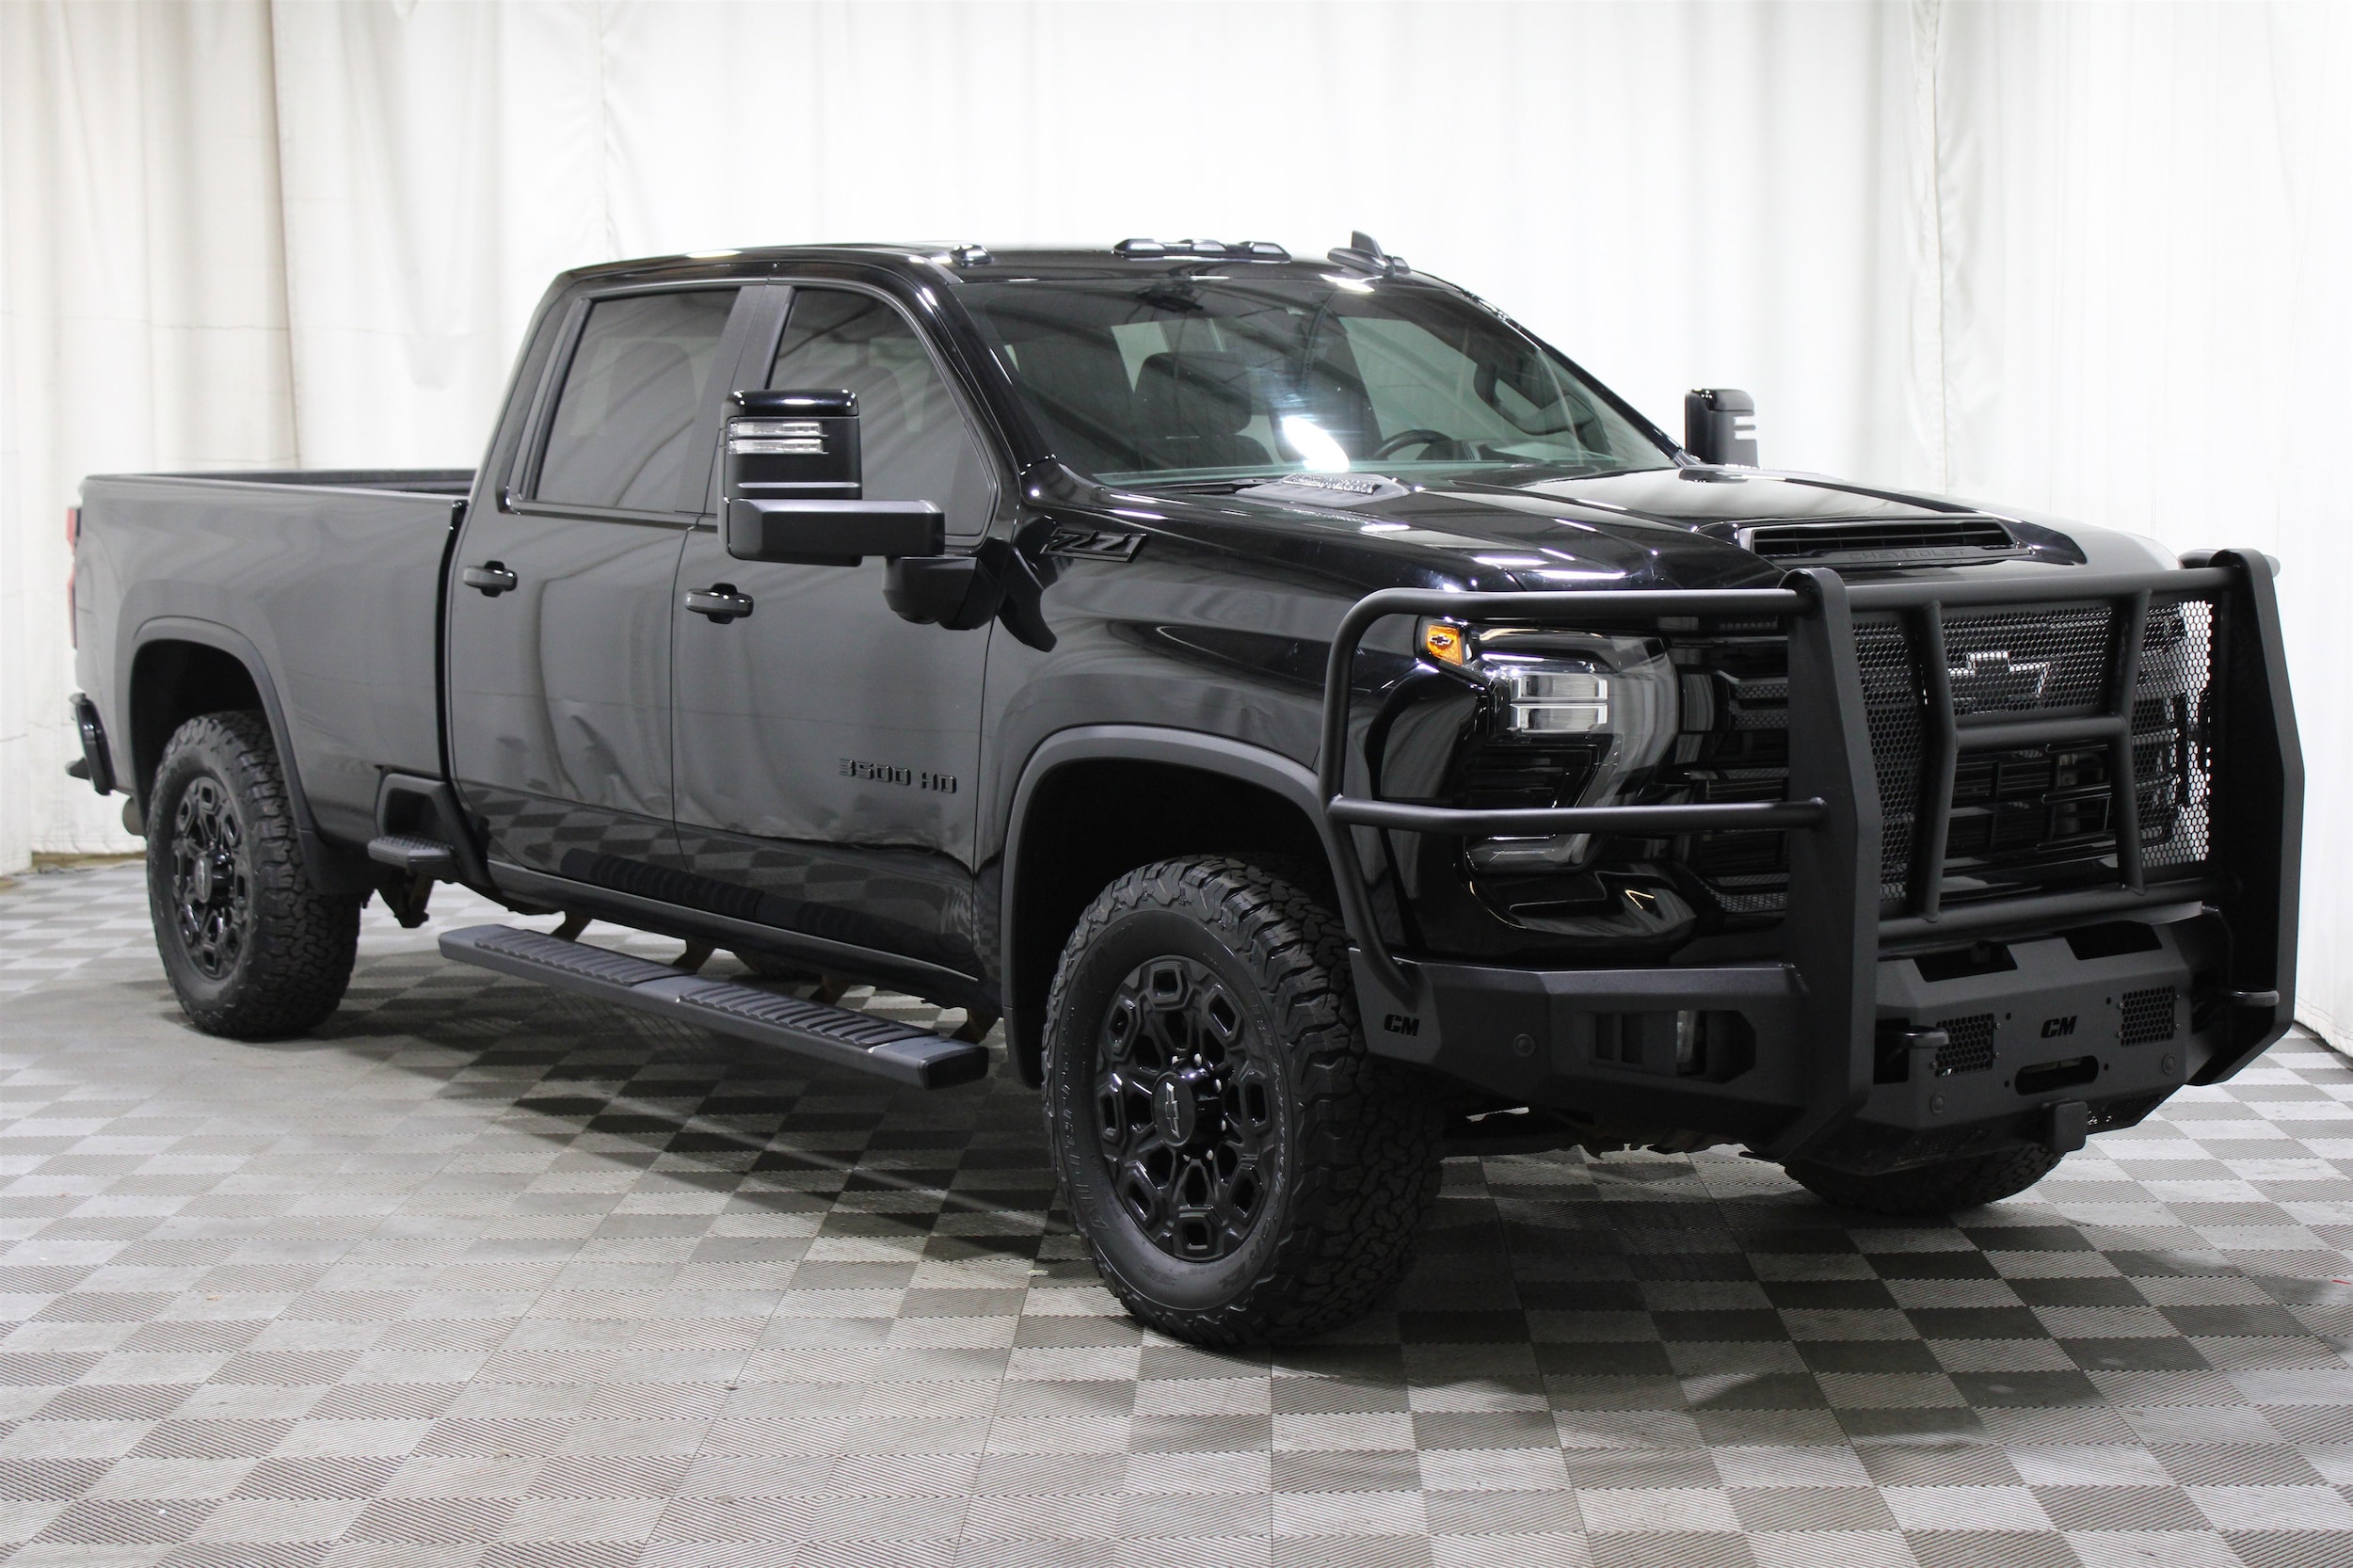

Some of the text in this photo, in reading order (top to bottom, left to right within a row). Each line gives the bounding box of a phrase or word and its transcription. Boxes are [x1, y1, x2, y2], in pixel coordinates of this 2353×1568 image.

[1040, 525, 1149, 563] Z71
[1848, 548, 1965, 562] CHEVROLET
[840, 758, 957, 794] 3500 HD
[1385, 1014, 1420, 1037] CM
[2041, 1016, 2078, 1038] CM
